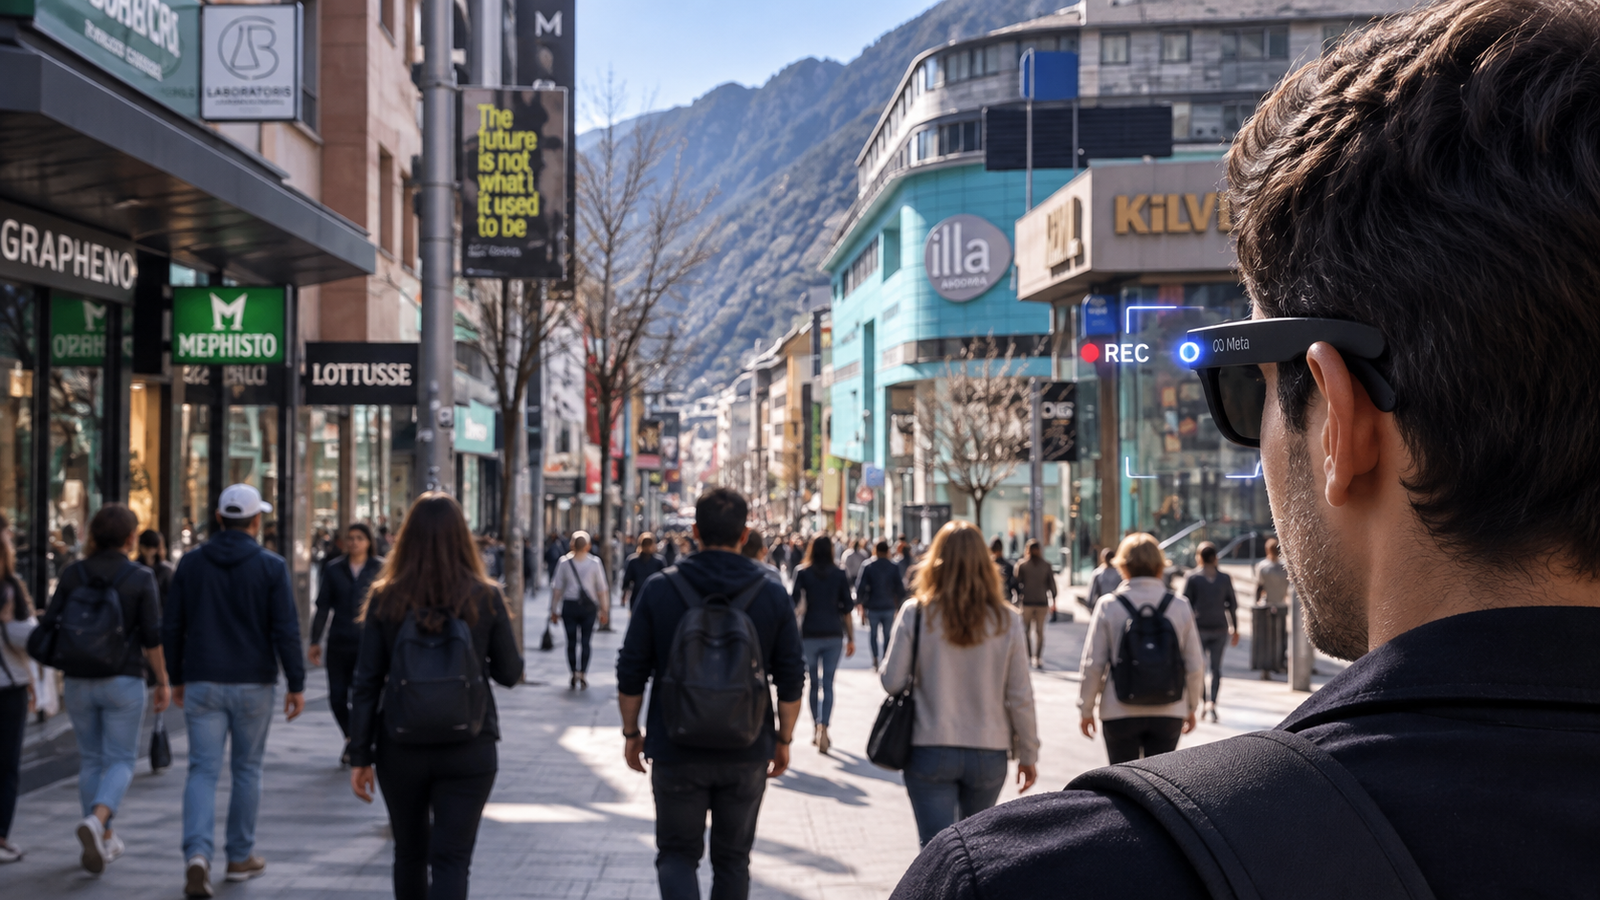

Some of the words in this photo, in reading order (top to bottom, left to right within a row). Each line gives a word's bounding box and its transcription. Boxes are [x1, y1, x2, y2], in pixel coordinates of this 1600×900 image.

[534, 10, 563, 37] M
[477, 103, 514, 129] The
[477, 126, 538, 152] future
[477, 148, 495, 173] is
[498, 150, 531, 173] not
[477, 171, 525, 194] what
[477, 191, 492, 215] it
[494, 191, 540, 216] used
[477, 215, 499, 237] to
[501, 214, 528, 237] be
[1, 218, 135, 290] GRAPHENO
[932, 222, 990, 277] illa
[209, 292, 248, 331] M
[178, 332, 278, 358] MEPHISTO
[1226, 336, 1250, 351] Meta
[312, 362, 412, 387] LOTTUSSE
